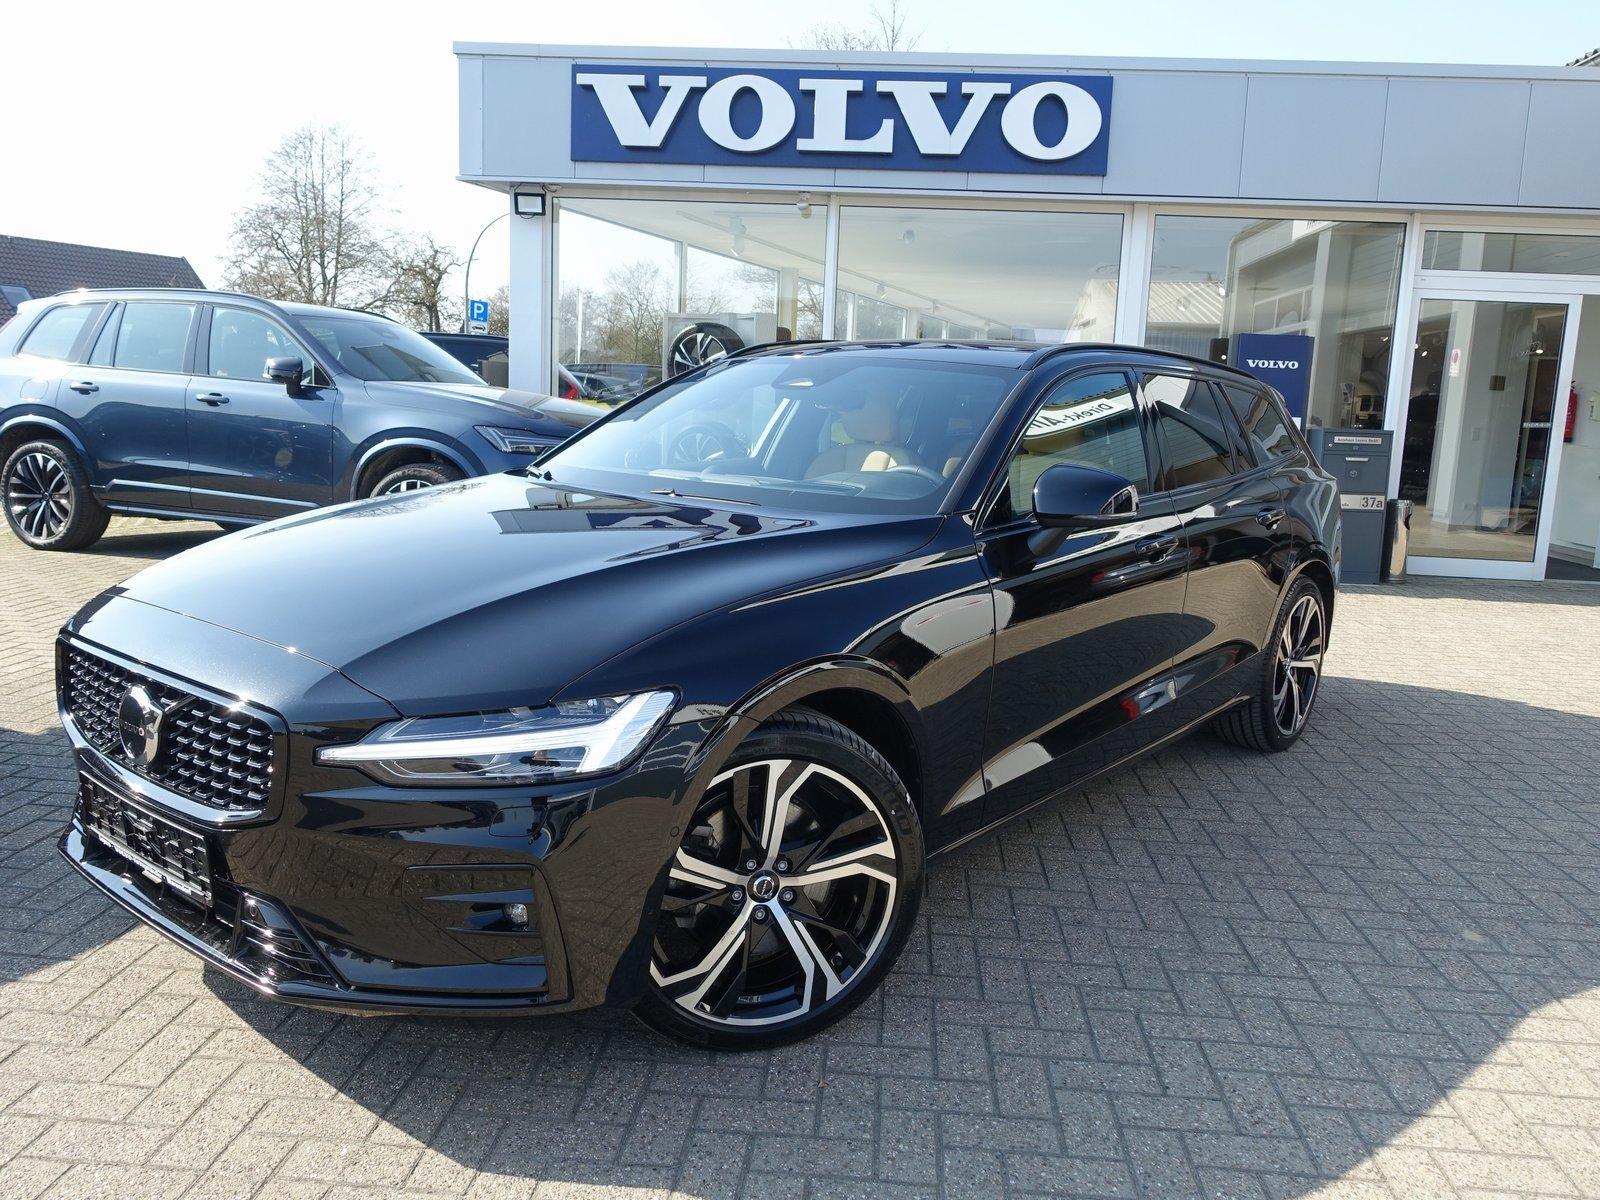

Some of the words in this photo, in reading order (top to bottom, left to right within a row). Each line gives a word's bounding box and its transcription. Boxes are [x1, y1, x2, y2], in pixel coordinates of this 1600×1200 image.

[576, 73, 1102, 160] VOLVO
[474, 303, 484, 319] P
[1246, 359, 1299, 369] VOLVO
[1362, 496, 1383, 508] 37a
